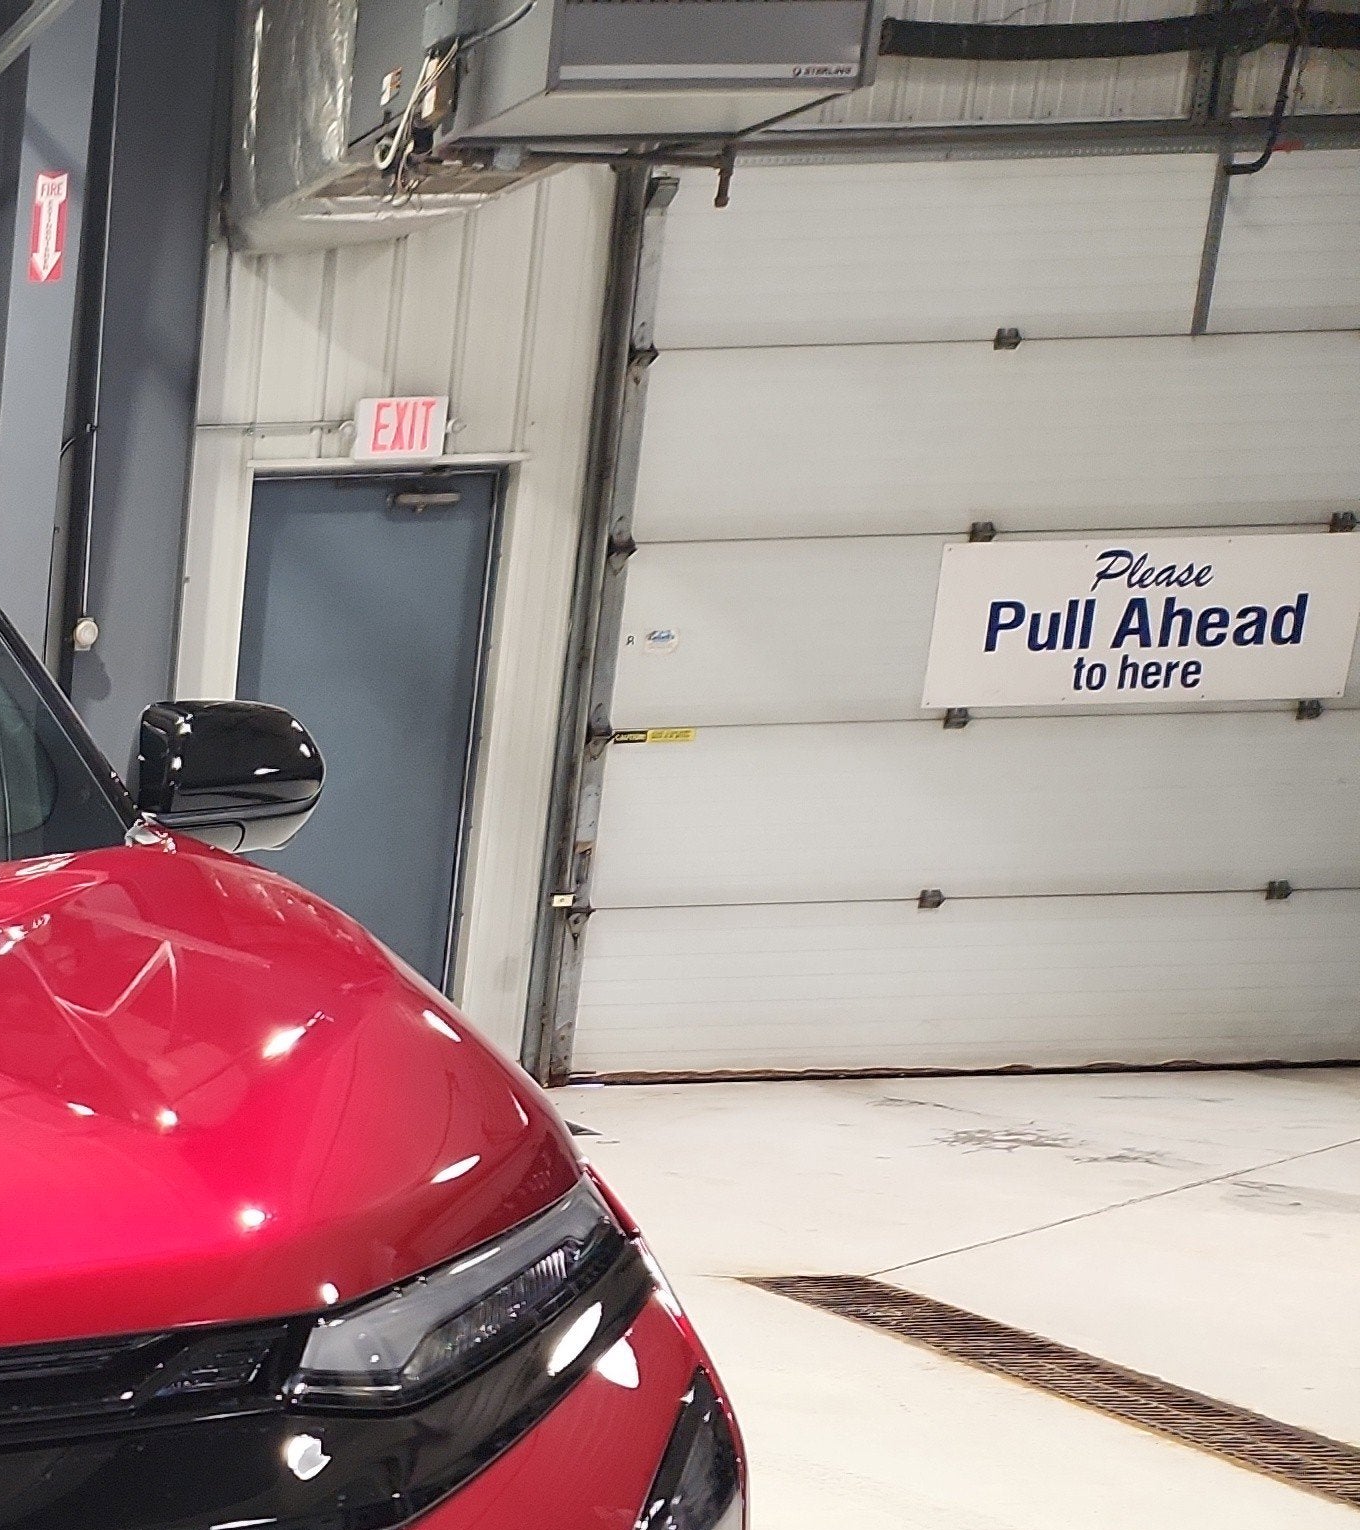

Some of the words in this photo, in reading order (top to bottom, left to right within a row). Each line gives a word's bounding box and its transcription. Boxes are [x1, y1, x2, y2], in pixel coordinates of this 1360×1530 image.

[41, 182, 63, 197] FIRE
[372, 401, 436, 451] EXIT
[1090, 549, 1214, 592] Please
[984, 598, 1097, 652] Pull
[1110, 593, 1310, 650] Ahead
[1073, 656, 1107, 690] to
[1116, 655, 1202, 690] here
